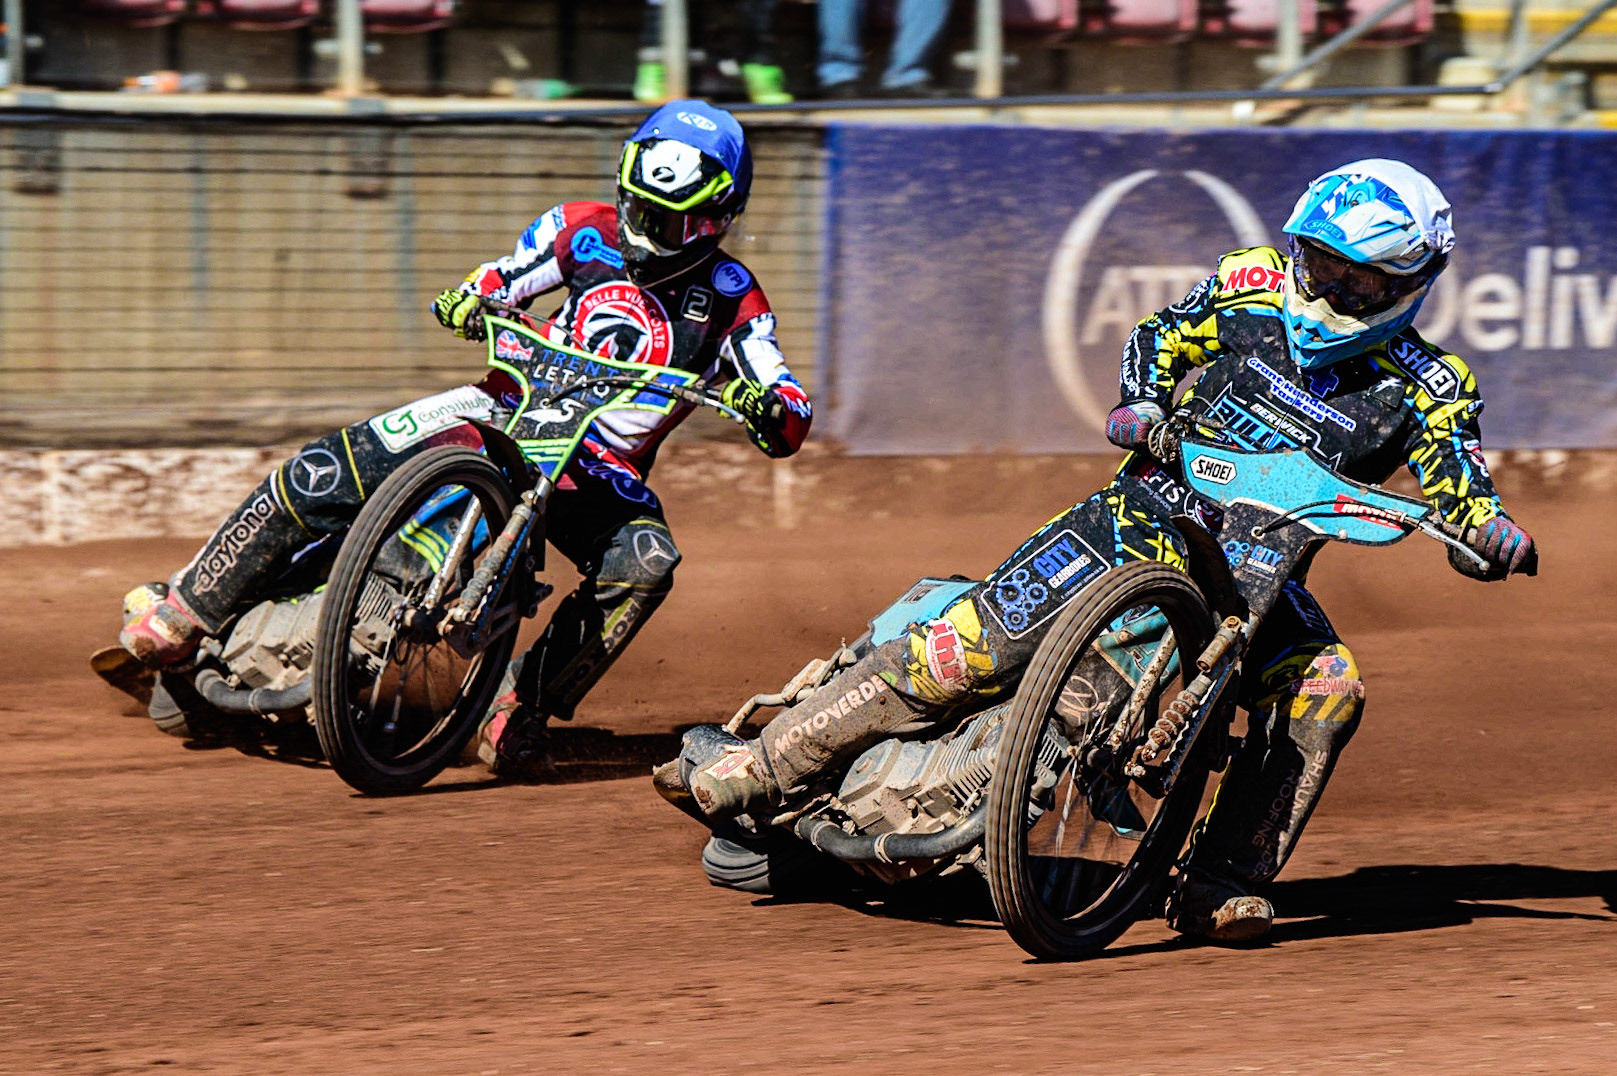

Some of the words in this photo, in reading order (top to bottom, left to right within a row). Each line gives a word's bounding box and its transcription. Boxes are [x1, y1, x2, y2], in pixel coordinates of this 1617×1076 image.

[1310, 220, 1343, 239] SHOEI
[1222, 266, 1287, 295] MOT
[583, 289, 620, 311] BELLE
[624, 290, 646, 309] VUE
[647, 308, 666, 349] COLTS
[540, 348, 619, 378] TRENT
[1394, 340, 1456, 397] SHOEI
[1248, 359, 1284, 384] Grant
[1284, 381, 1355, 430] Henderson
[1271, 384, 1325, 421] Tankers
[382, 408, 418, 436] CJ
[1250, 403, 1312, 444] BERWICK
[1196, 459, 1232, 481] SHOEI
[193, 493, 276, 596] daytona
[1033, 538, 1079, 578] CITY
[1250, 544, 1284, 566] CITY
[1047, 553, 1092, 589] GEARBOXES
[774, 674, 888, 760] MOTOVERDE
[1292, 750, 1328, 815] SHAUN
[1251, 768, 1298, 848] ROOFING
